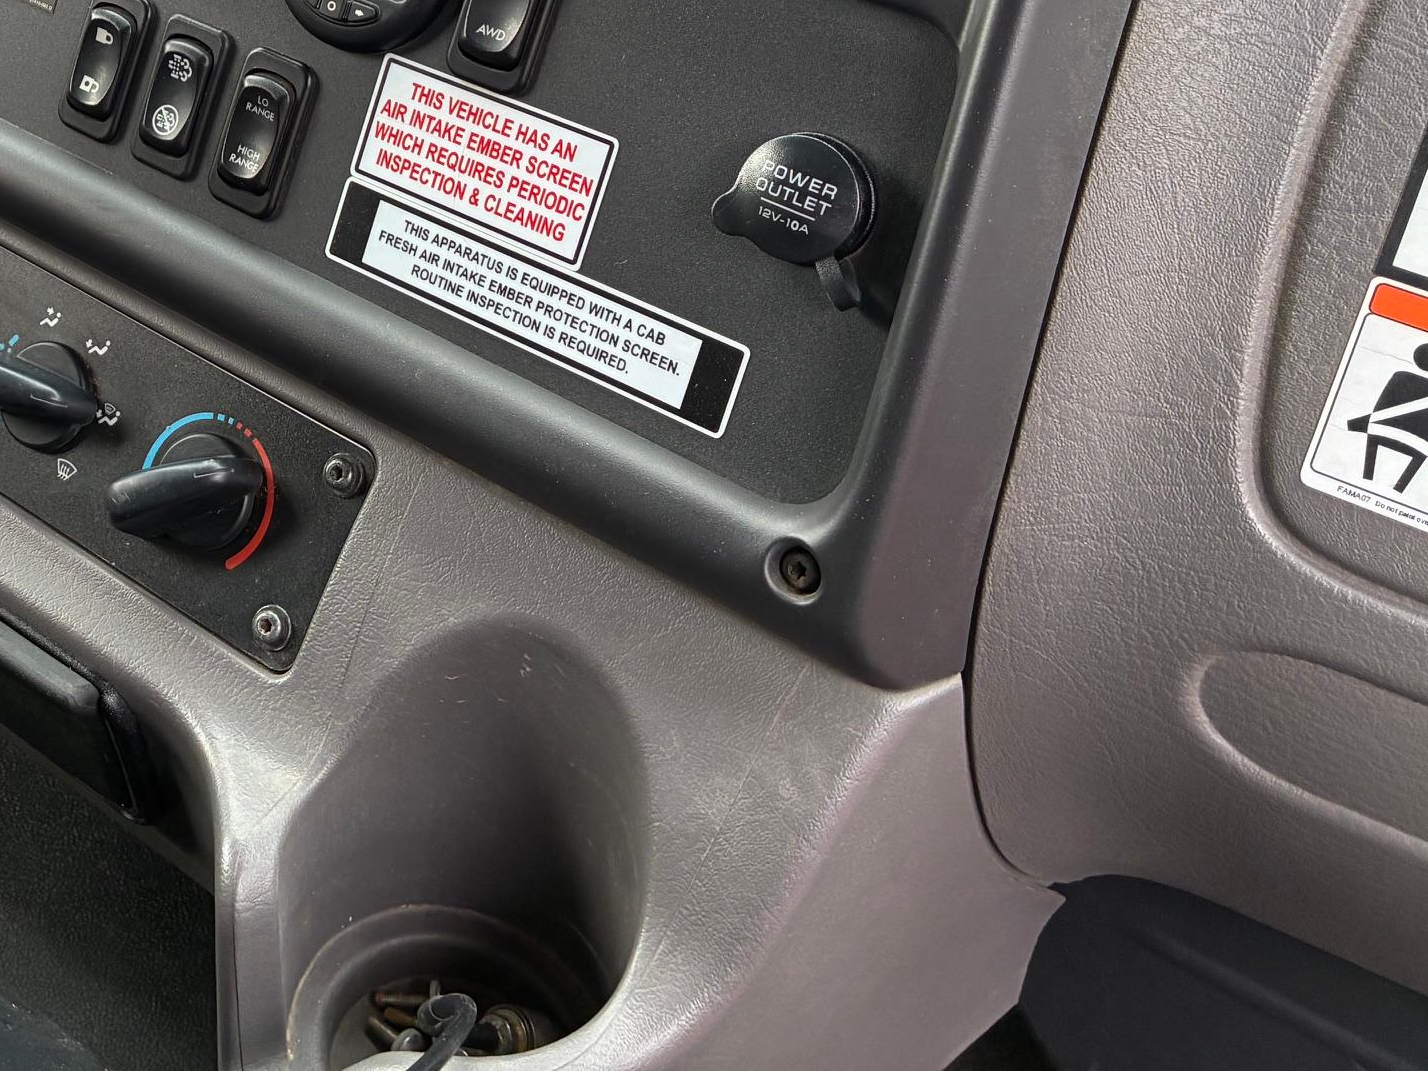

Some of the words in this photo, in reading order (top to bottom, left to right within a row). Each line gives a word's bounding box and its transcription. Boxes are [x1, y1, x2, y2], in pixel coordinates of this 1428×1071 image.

[476, 24, 506, 42] AWD
[245, 102, 275, 122] RANGE
[257, 95, 269, 108] LO
[411, 83, 445, 110] THIS
[448, 97, 515, 138] VEHICLE
[515, 123, 551, 152] HAS
[551, 139, 578, 163] AN
[229, 153, 258, 173] RANGE
[237, 144, 261, 162] HIGH
[380, 99, 408, 123] AIR
[409, 109, 466, 145] INTAKE
[466, 131, 523, 169] EMBER
[525, 156, 594, 197] SCREEN
[374, 121, 424, 156] WHICH
[425, 143, 504, 189] REQUIRES
[507, 176, 586, 222] PERIODIC
[762, 159, 838, 200] POWER
[376, 148, 467, 201] INSPECTION
[469, 188, 480, 207] &
[484, 194, 566, 242] CLEANING
[755, 177, 832, 216] OUTLET
[758, 206, 809, 235] 12V-10A
[404, 219, 430, 241] THIS
[431, 233, 504, 274] APPARATUS
[505, 265, 519, 280] IS
[521, 272, 585, 311] EQUIPPED
[588, 301, 622, 327] WITH
[623, 318, 633, 333] A
[636, 324, 666, 346] CAB
[378, 230, 418, 257] FRESH
[419, 250, 441, 267] AIR
[442, 258, 487, 288] INTAKE
[488, 279, 534, 309] EMBER
[535, 300, 620, 348] PROTECTION
[621, 339, 680, 376] SCREEN.
[410, 264, 465, 298] ROUTINE
[466, 289, 542, 333] INSPECTION
[543, 324, 556, 339] IS
[558, 331, 629, 374] REQUIRED.
[1337, 485, 1371, 503] FAMA07
[1375, 500, 1386, 509] Do
[1386, 506, 1399, 514] not
